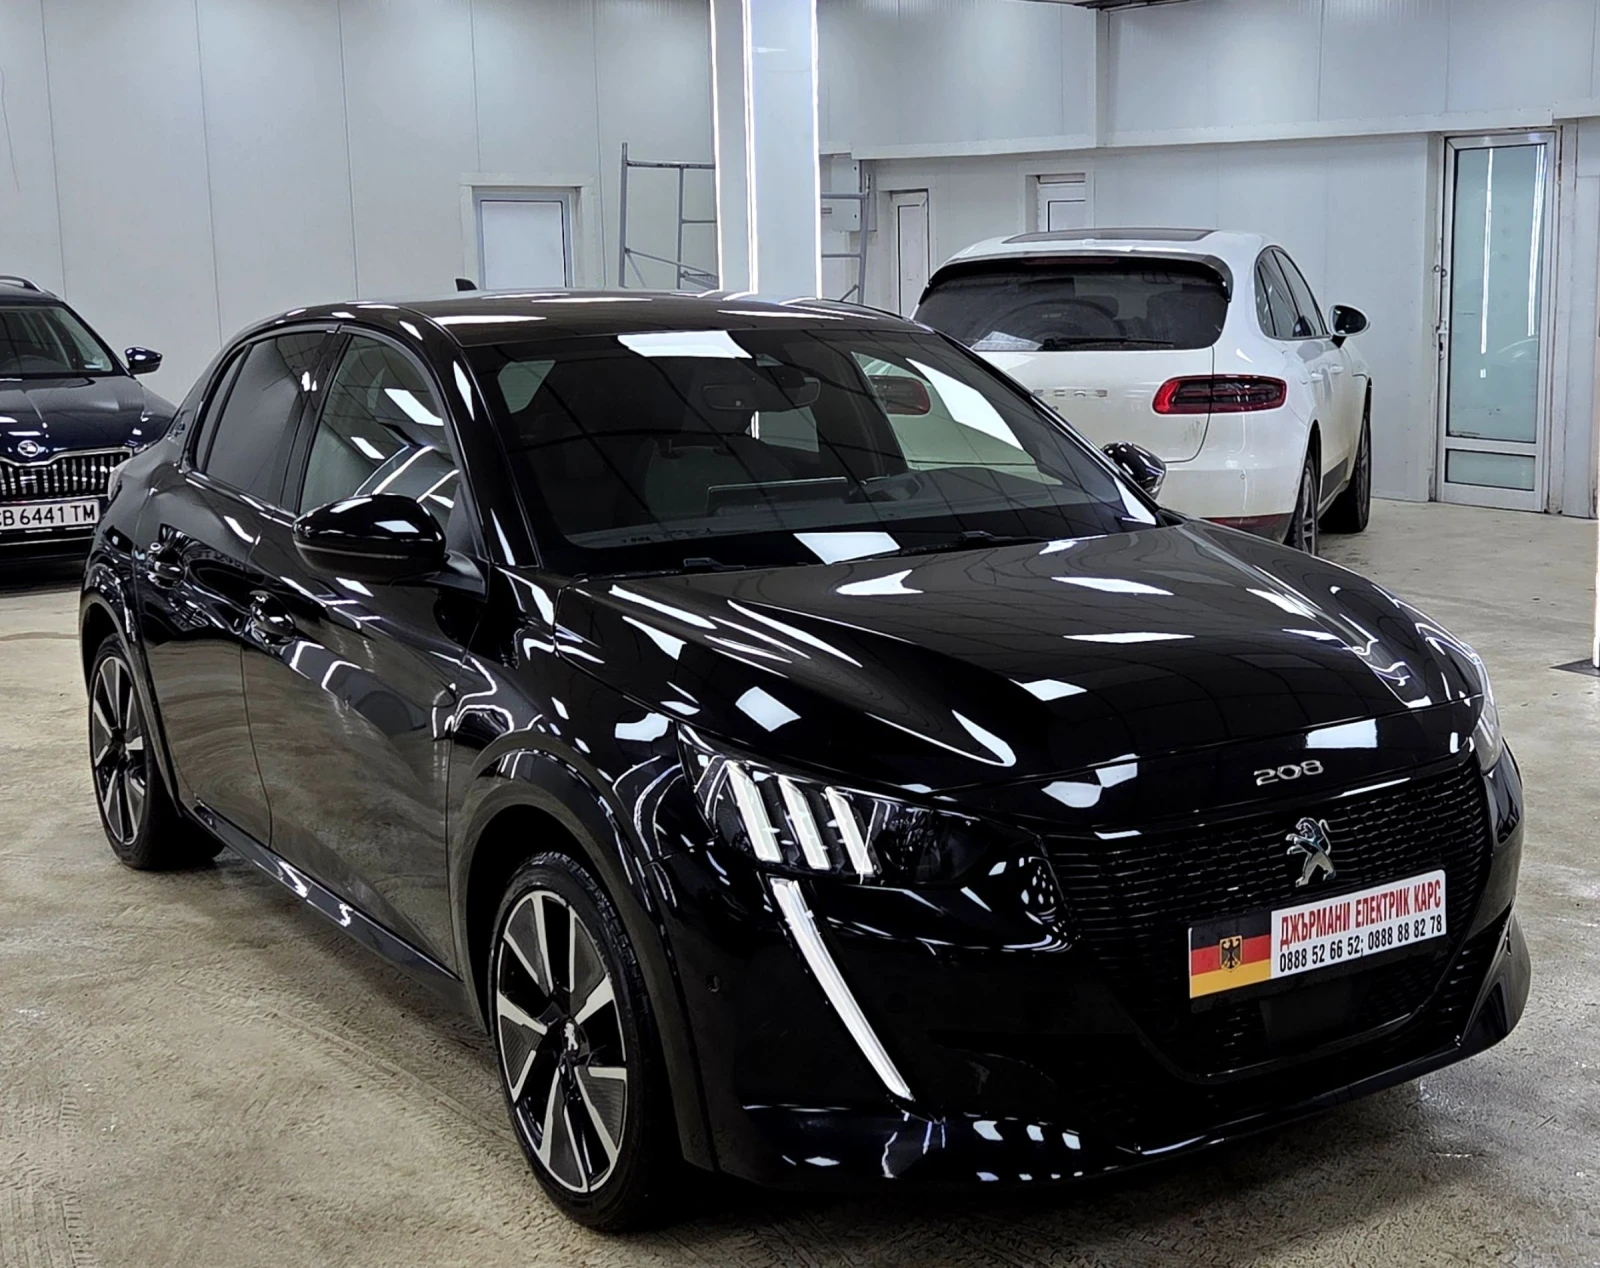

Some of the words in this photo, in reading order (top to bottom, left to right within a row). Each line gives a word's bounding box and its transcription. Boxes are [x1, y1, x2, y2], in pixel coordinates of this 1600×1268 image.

[20, 506, 65, 525] 6441
[70, 504, 95, 522] TM
[1253, 759, 1324, 787] 208
[1279, 902, 1351, 952] ДЖЪРМАНИ
[1355, 887, 1411, 929] ЕЛЕКТРИК
[1414, 879, 1442, 915] КАРС
[1279, 951, 1308, 973] 0888
[1312, 945, 1326, 965] 52
[1329, 941, 1344, 960] 66
[1347, 936, 1365, 957] 52;
[1367, 929, 1394, 951] 0888
[1397, 923, 1411, 943] 88
[1413, 919, 1427, 938] 82
[1430, 914, 1443, 933] 78
